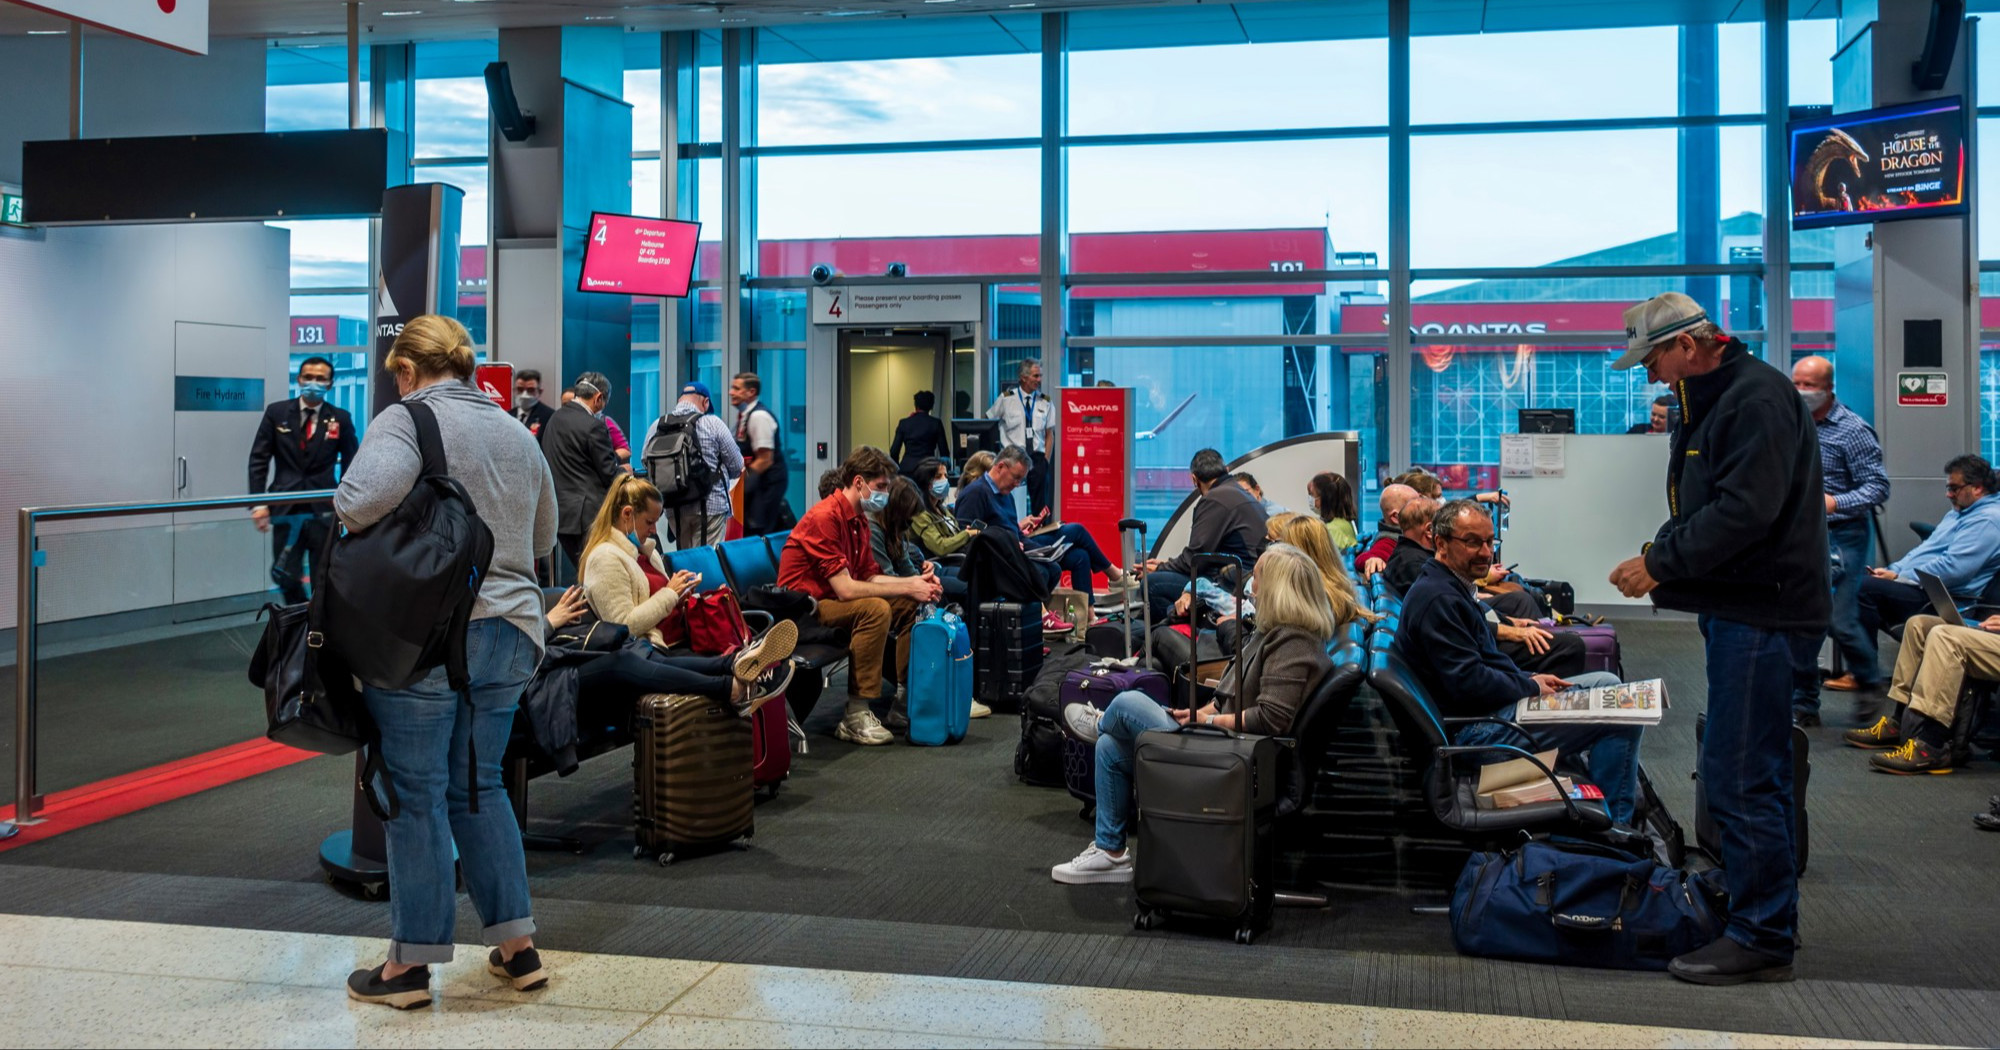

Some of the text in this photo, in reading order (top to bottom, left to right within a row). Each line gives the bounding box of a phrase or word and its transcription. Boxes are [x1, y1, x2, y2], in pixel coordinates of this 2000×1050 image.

[1882, 137, 1926, 155] HOUSE
[1881, 151, 1943, 171] DRAGON
[594, 225, 607, 246] 4
[640, 240, 664, 248] Melbourne
[828, 296, 842, 318] 4
[297, 326, 324, 344] 131
[196, 388, 246, 402] Fire Hydrant
[1093, 426, 1118, 434] Baggage
